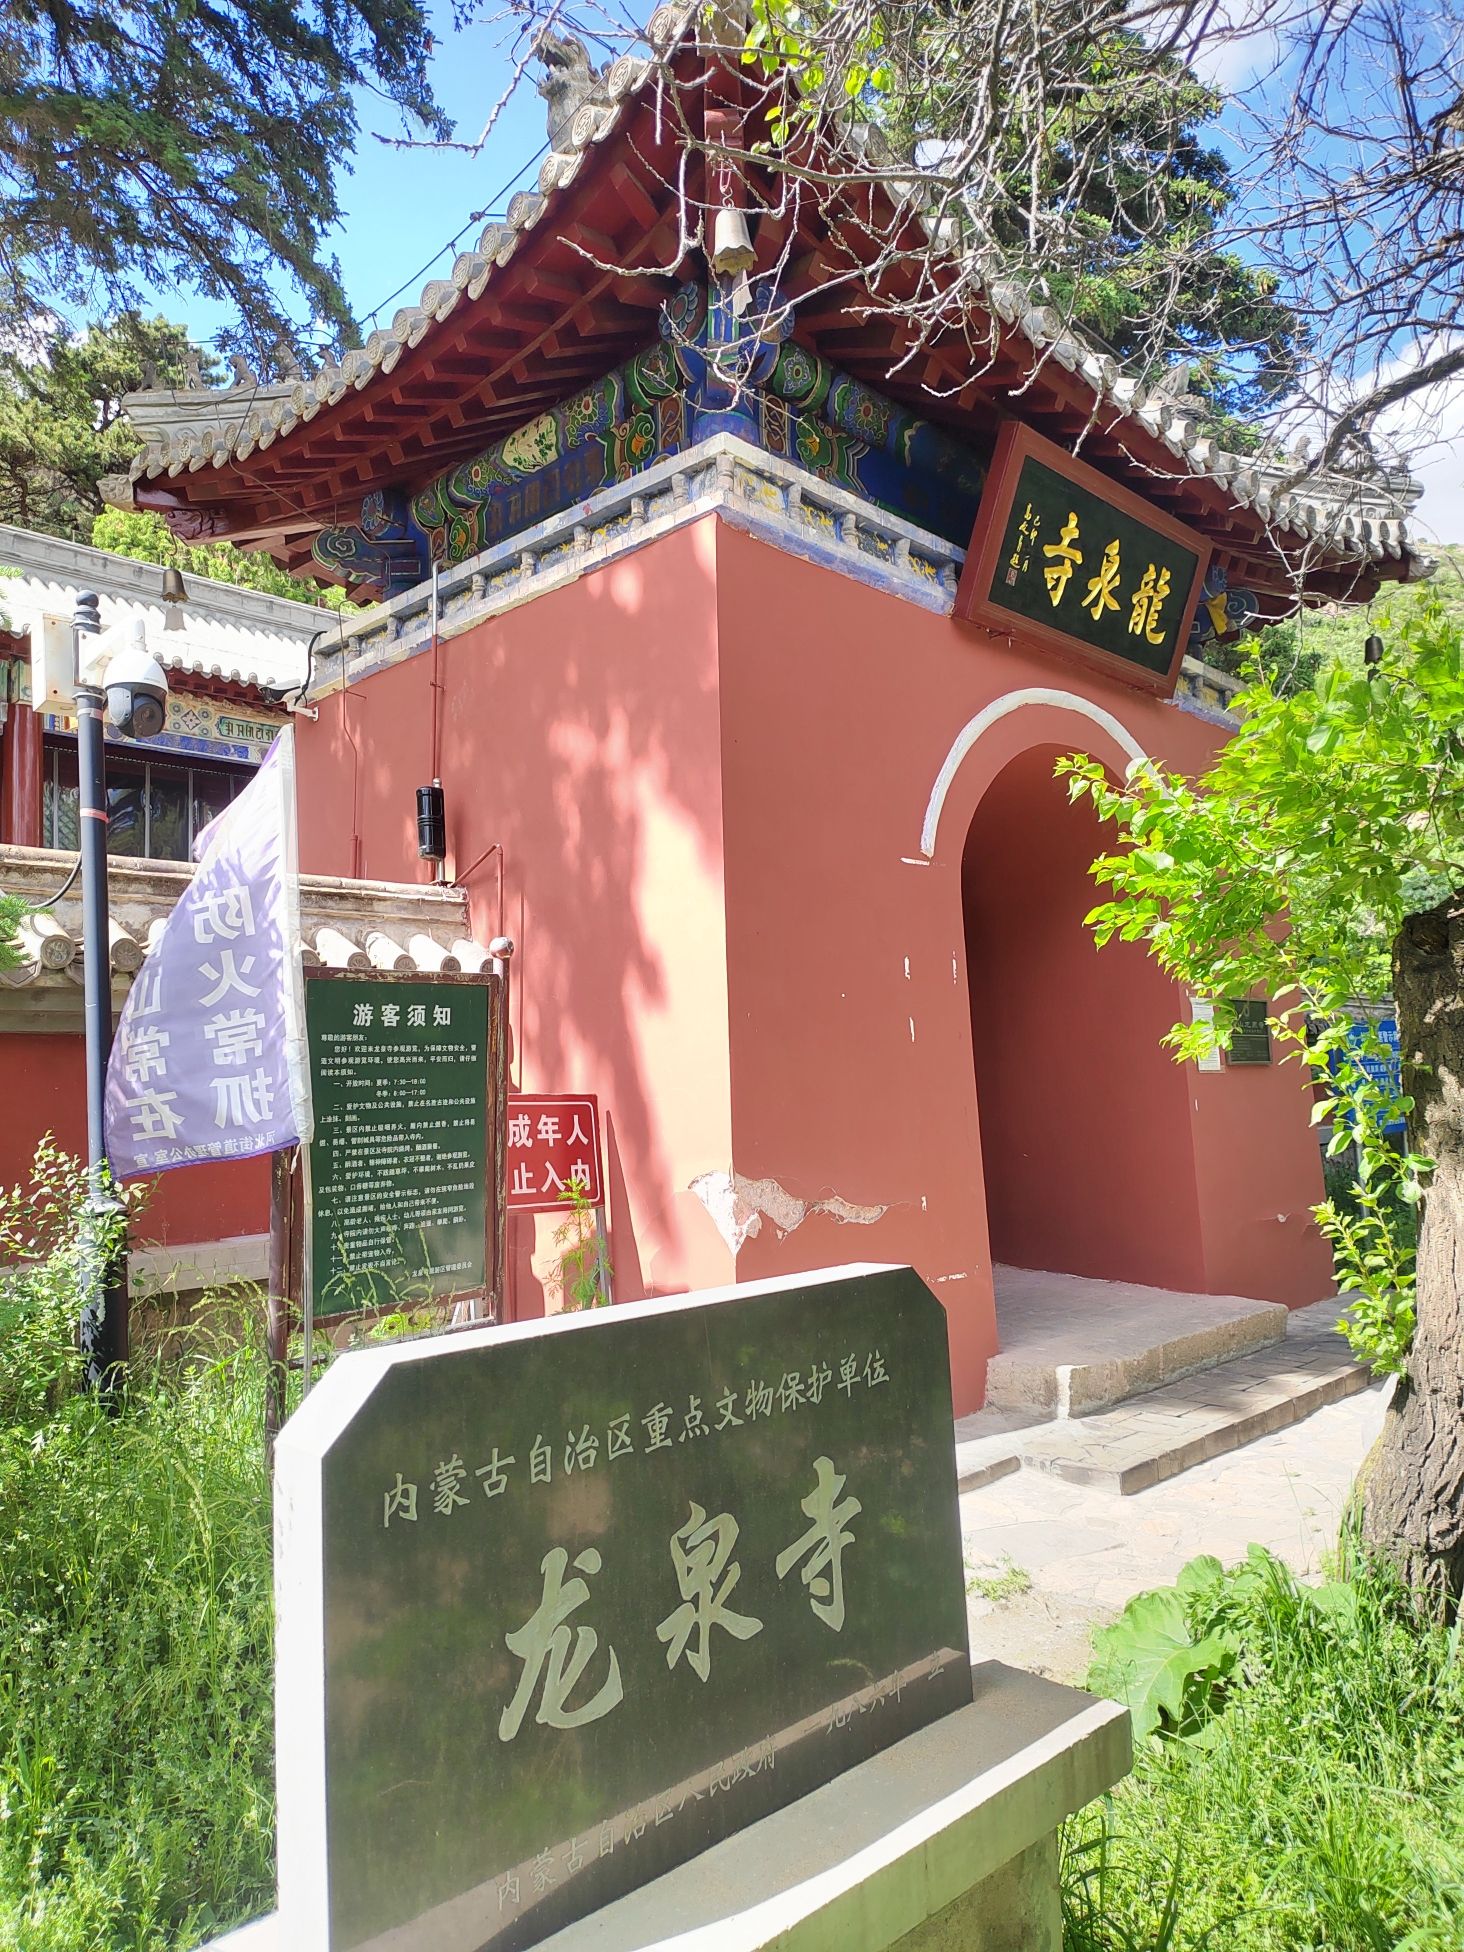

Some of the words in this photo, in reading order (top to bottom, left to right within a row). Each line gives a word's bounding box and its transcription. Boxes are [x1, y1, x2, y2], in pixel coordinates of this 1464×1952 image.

[1043, 511, 1172, 645] 龍泉寺
[353, 1003, 451, 1027] 游客须知
[507, 1113, 589, 1148] 成年人
[511, 1158, 591, 1194] 止入内
[384, 1348, 890, 1528] 内蒙古自治区重点文物保护单位
[499, 1455, 863, 1742] 龙泉寺
[498, 1734, 777, 1911] 内蒙古自治区人民政府
